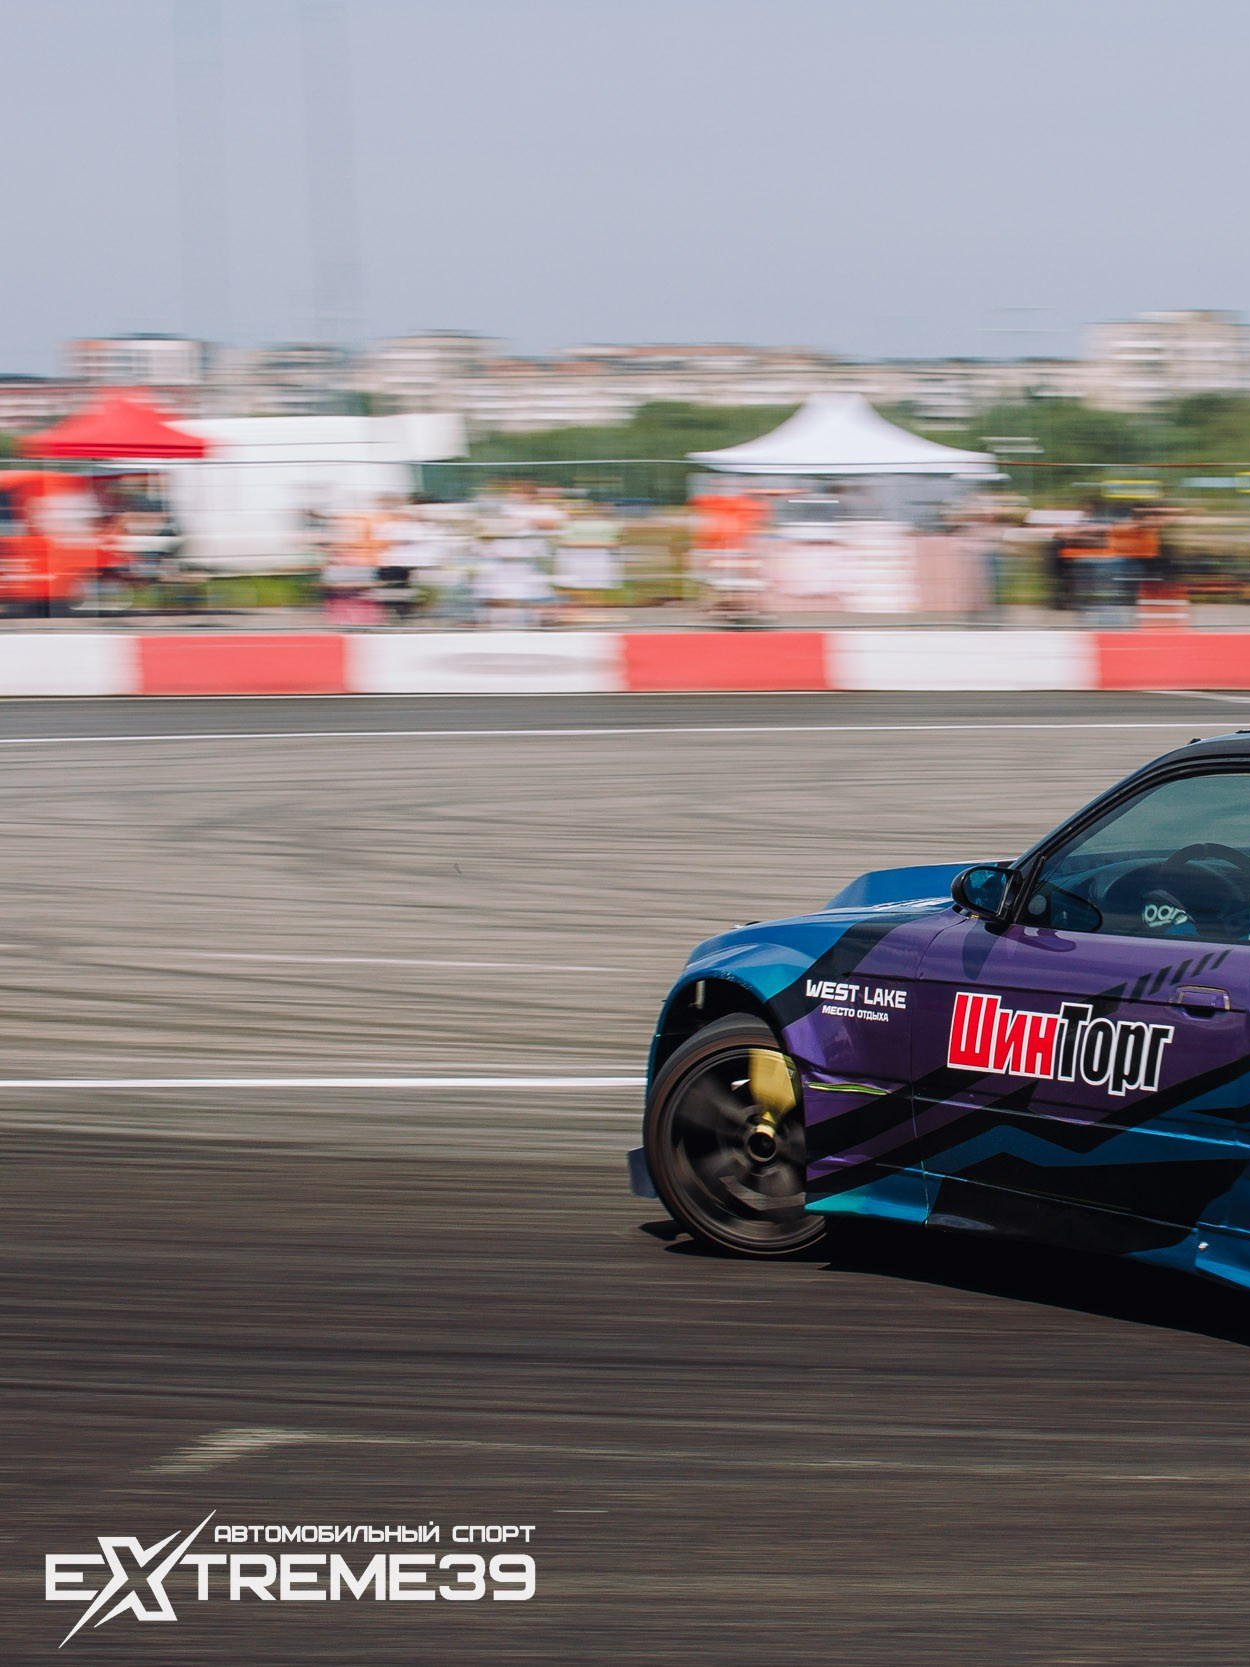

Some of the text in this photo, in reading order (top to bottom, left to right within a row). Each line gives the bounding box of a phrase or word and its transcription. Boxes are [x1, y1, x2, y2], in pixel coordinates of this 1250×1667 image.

[806, 979, 907, 1010] WEST LAKE
[822, 1004, 889, 1022] МЕСТО ОТДЫХА
[947, 992, 1174, 1096] ШинТорг
